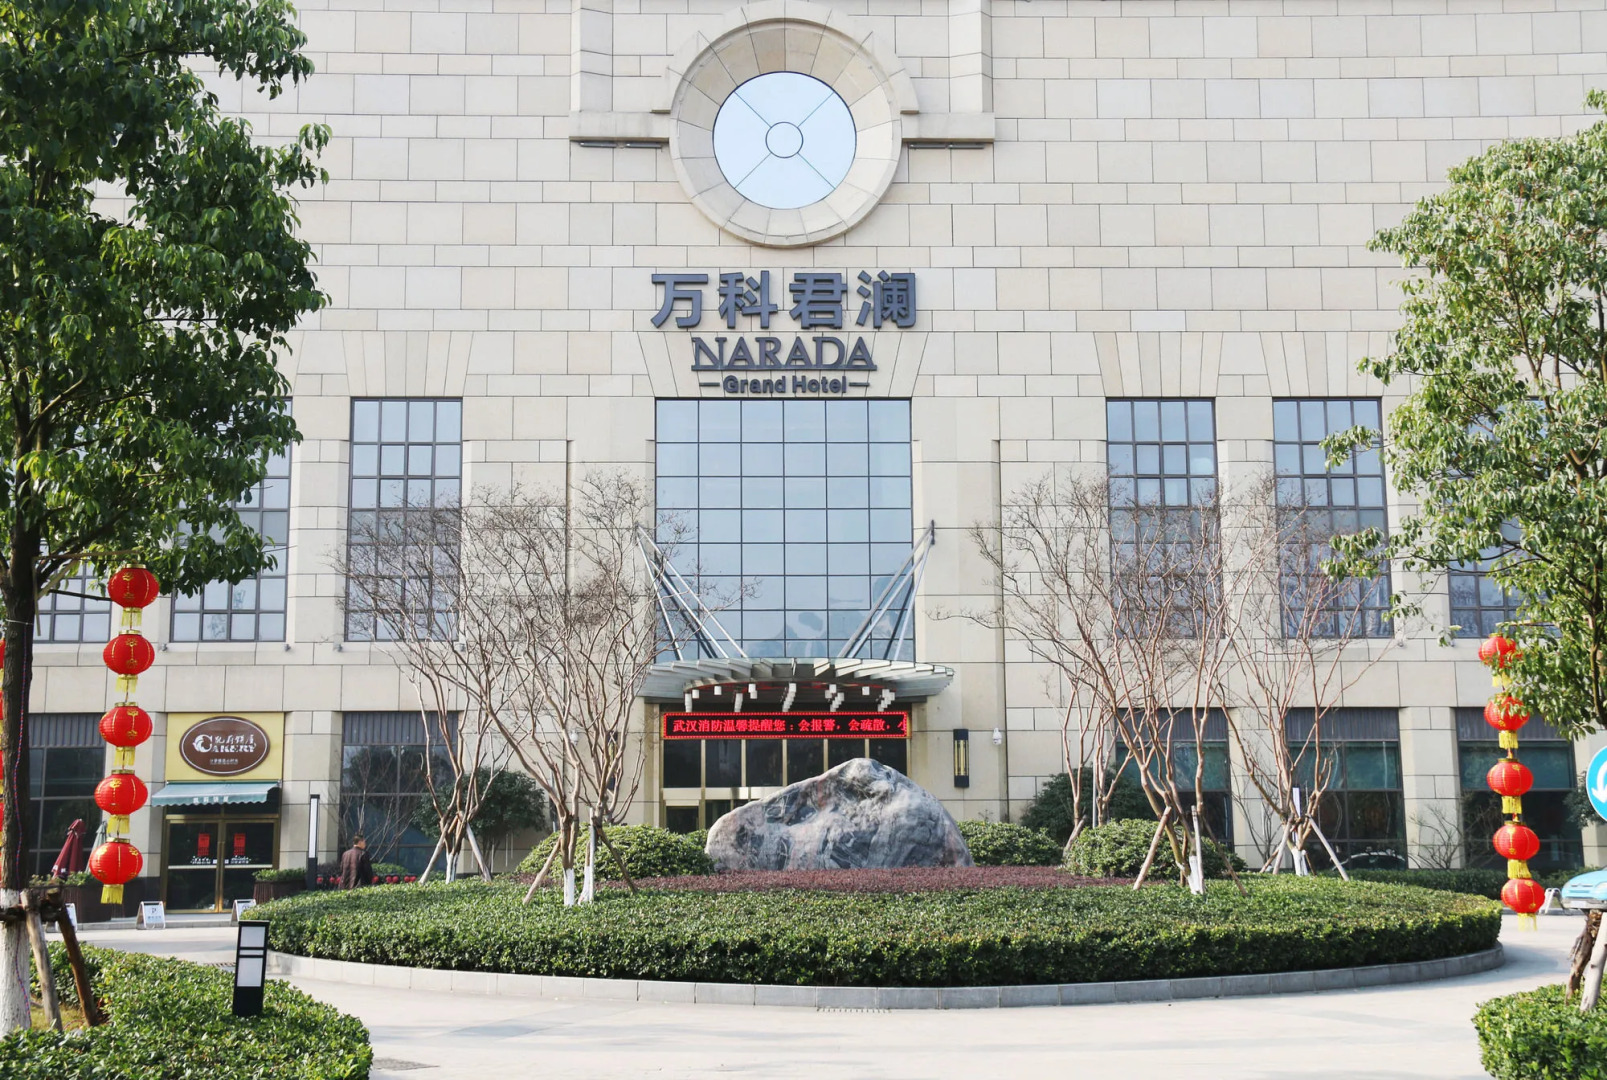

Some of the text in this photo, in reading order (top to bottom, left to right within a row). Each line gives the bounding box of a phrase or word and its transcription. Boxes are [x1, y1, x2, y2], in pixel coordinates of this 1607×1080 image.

[650, 270, 917, 329] 万科君澜
[691, 337, 878, 371] NARADA
[723, 375, 847, 393] Grand Hotel
